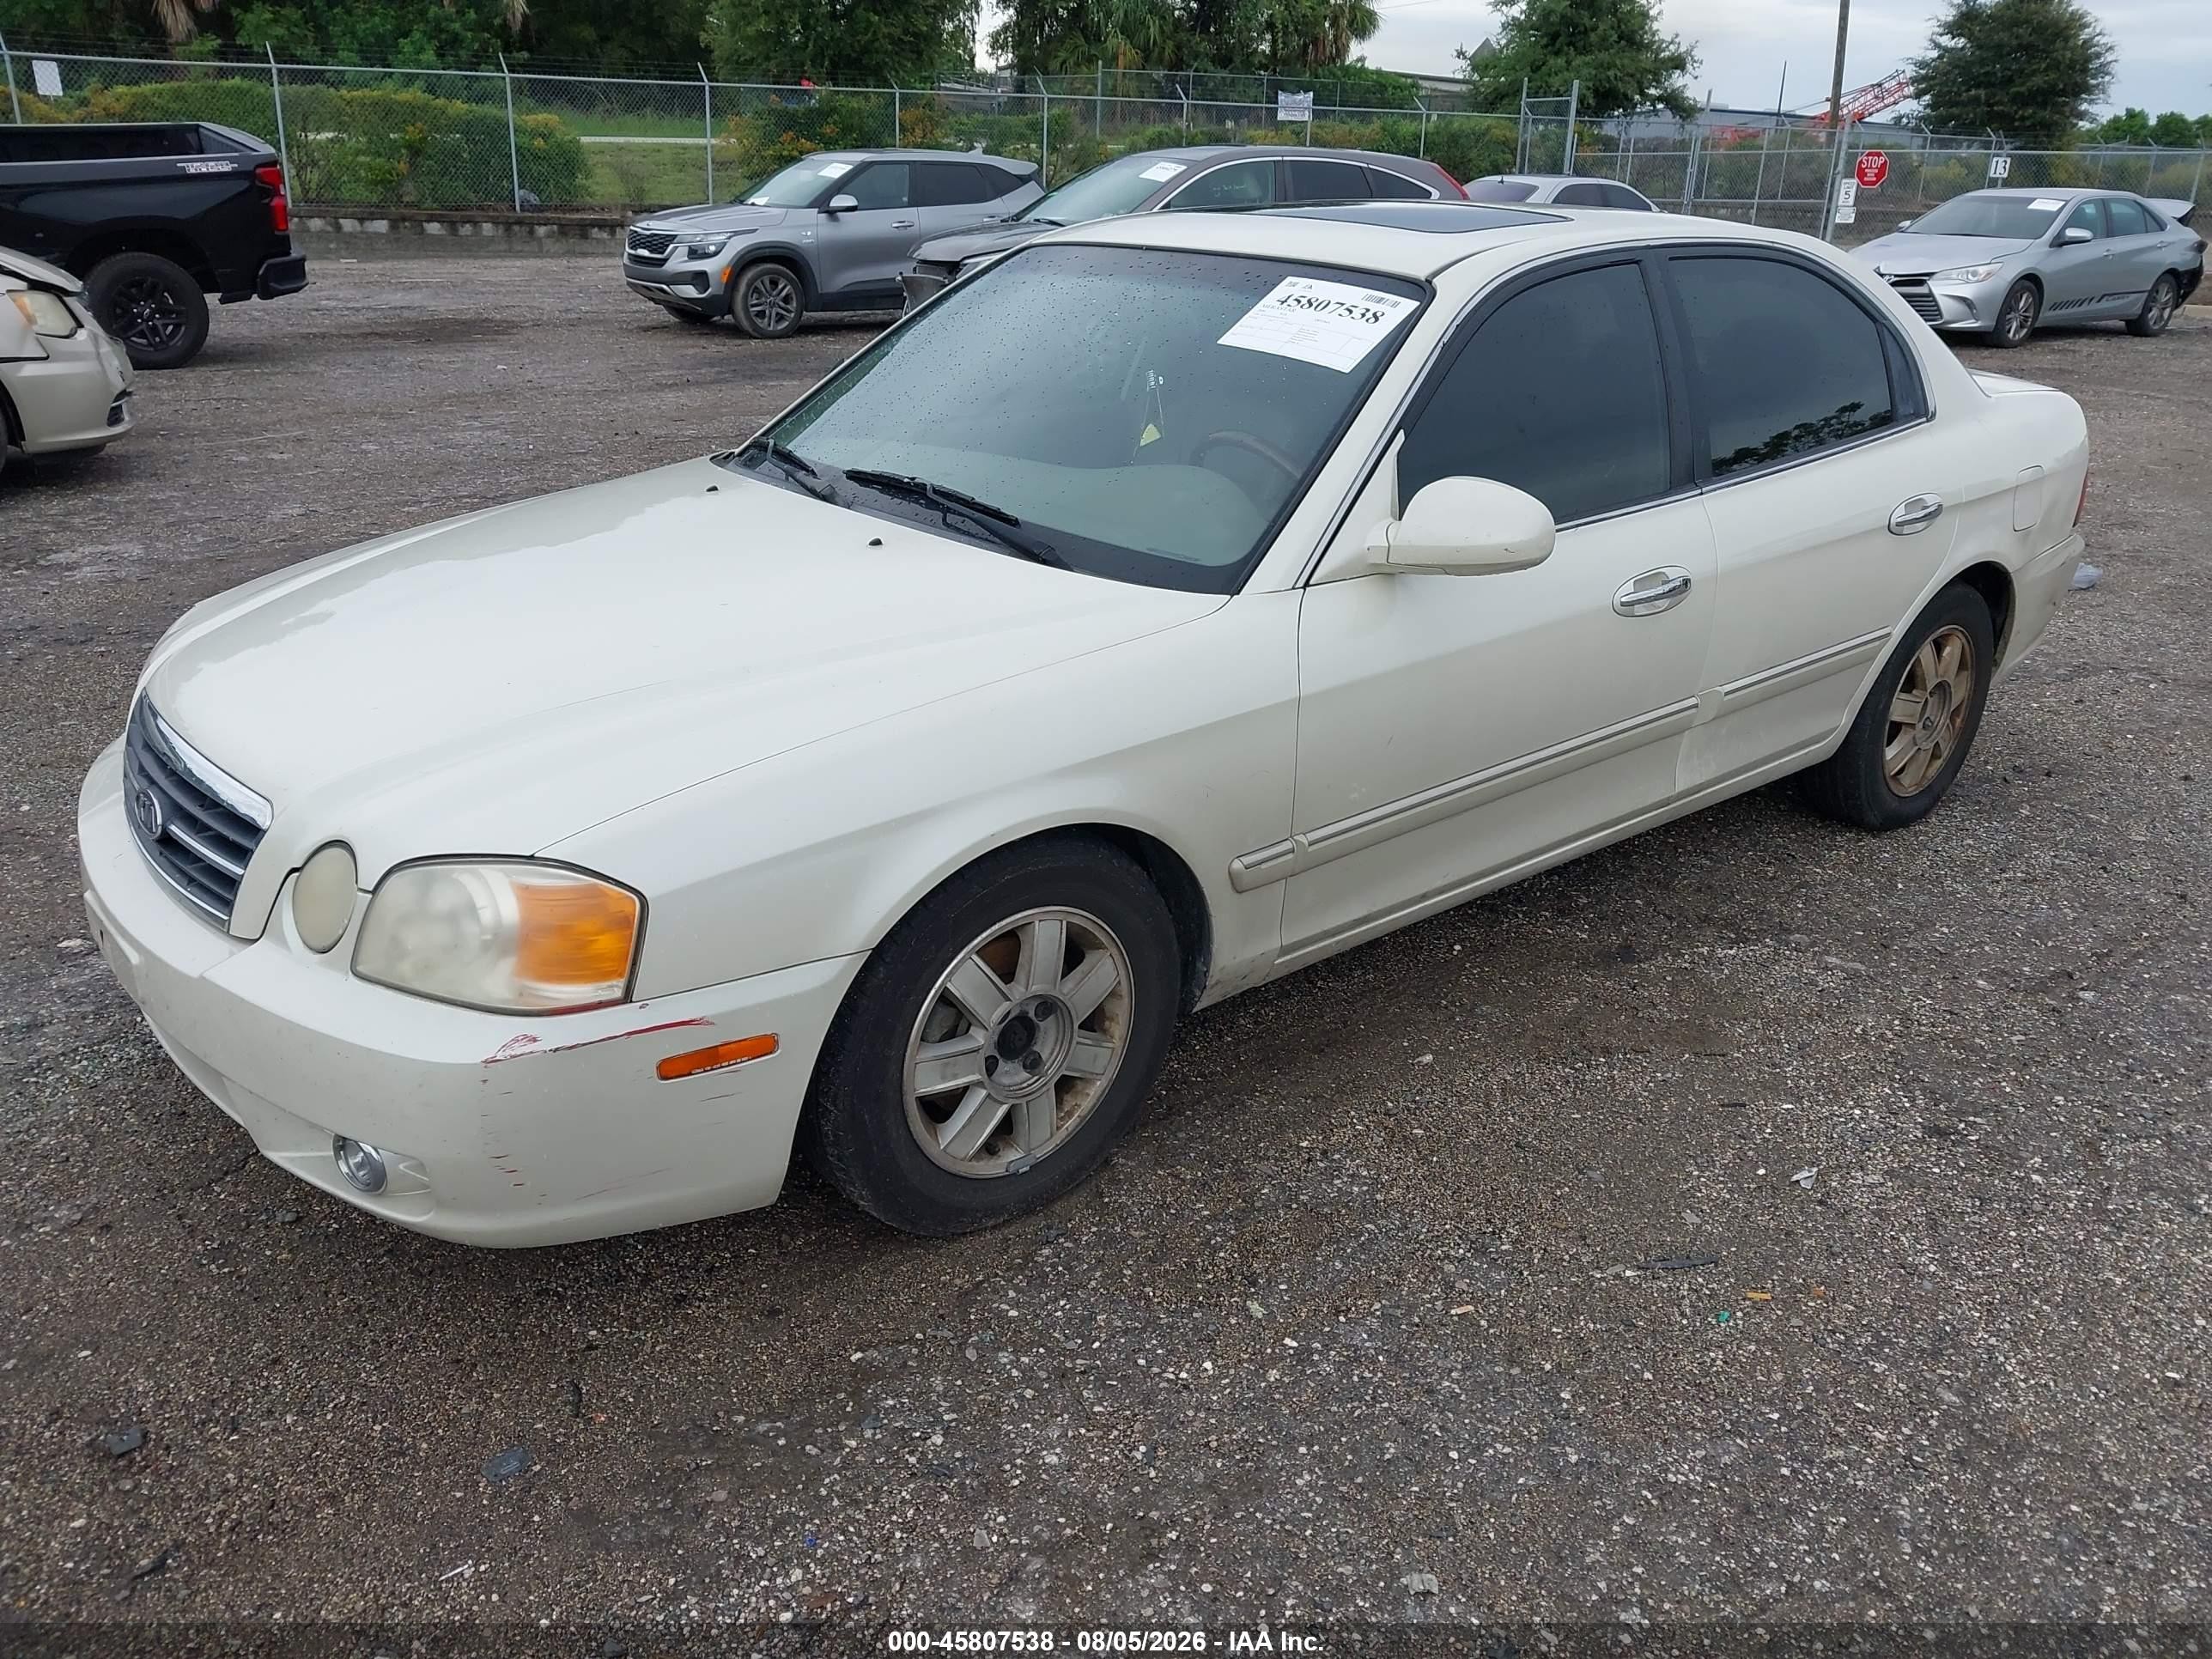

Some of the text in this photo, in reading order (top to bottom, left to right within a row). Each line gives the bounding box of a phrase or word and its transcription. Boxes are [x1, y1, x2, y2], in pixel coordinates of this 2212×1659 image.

[1862, 156, 1885, 167] STOP
[1993, 160, 2008, 175] 13
[1844, 190, 1850, 199] 5
[1276, 294, 1386, 324] 45807538
